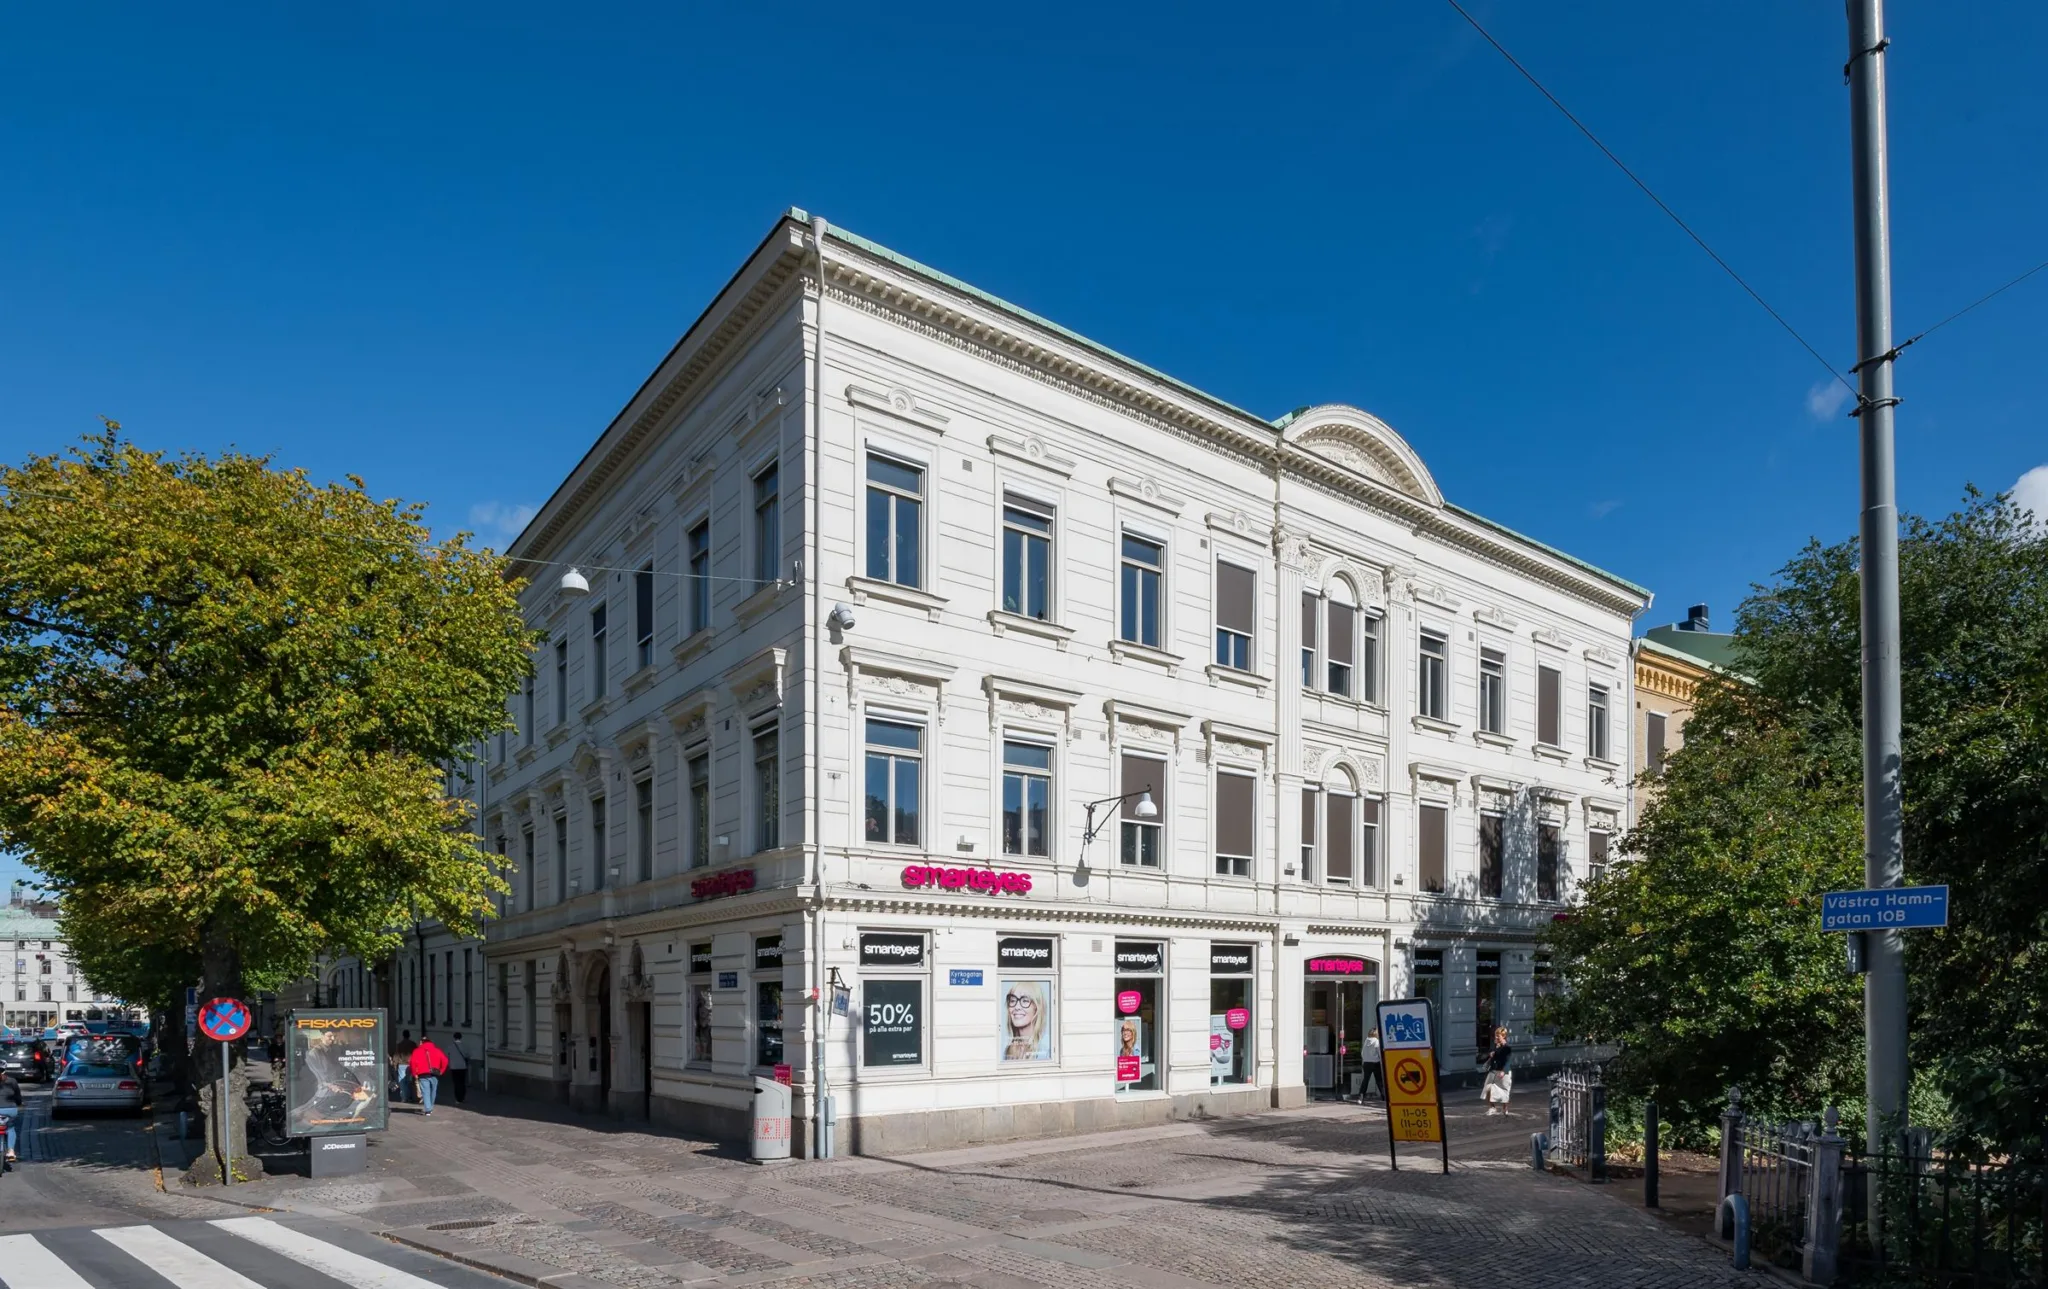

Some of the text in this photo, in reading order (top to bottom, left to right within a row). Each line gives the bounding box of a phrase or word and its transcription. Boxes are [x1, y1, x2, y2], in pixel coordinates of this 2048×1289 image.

[904, 865, 1032, 895] smarteyes
[1827, 894, 1943, 909] Västra Hamn-
[1827, 910, 1906, 927] gatan 10B
[864, 944, 919, 956] smarteyes
[1001, 947, 1049, 959] smarteyes
[1117, 952, 1158, 964] smarteyes
[1212, 955, 1248, 965] smarteyes
[1310, 958, 1363, 975] smarteyes
[951, 971, 983, 979] Kyrkogatan
[870, 1003, 914, 1025] 50%
[297, 1018, 375, 1029] FISKARS
[869, 1026, 877, 1034] på
